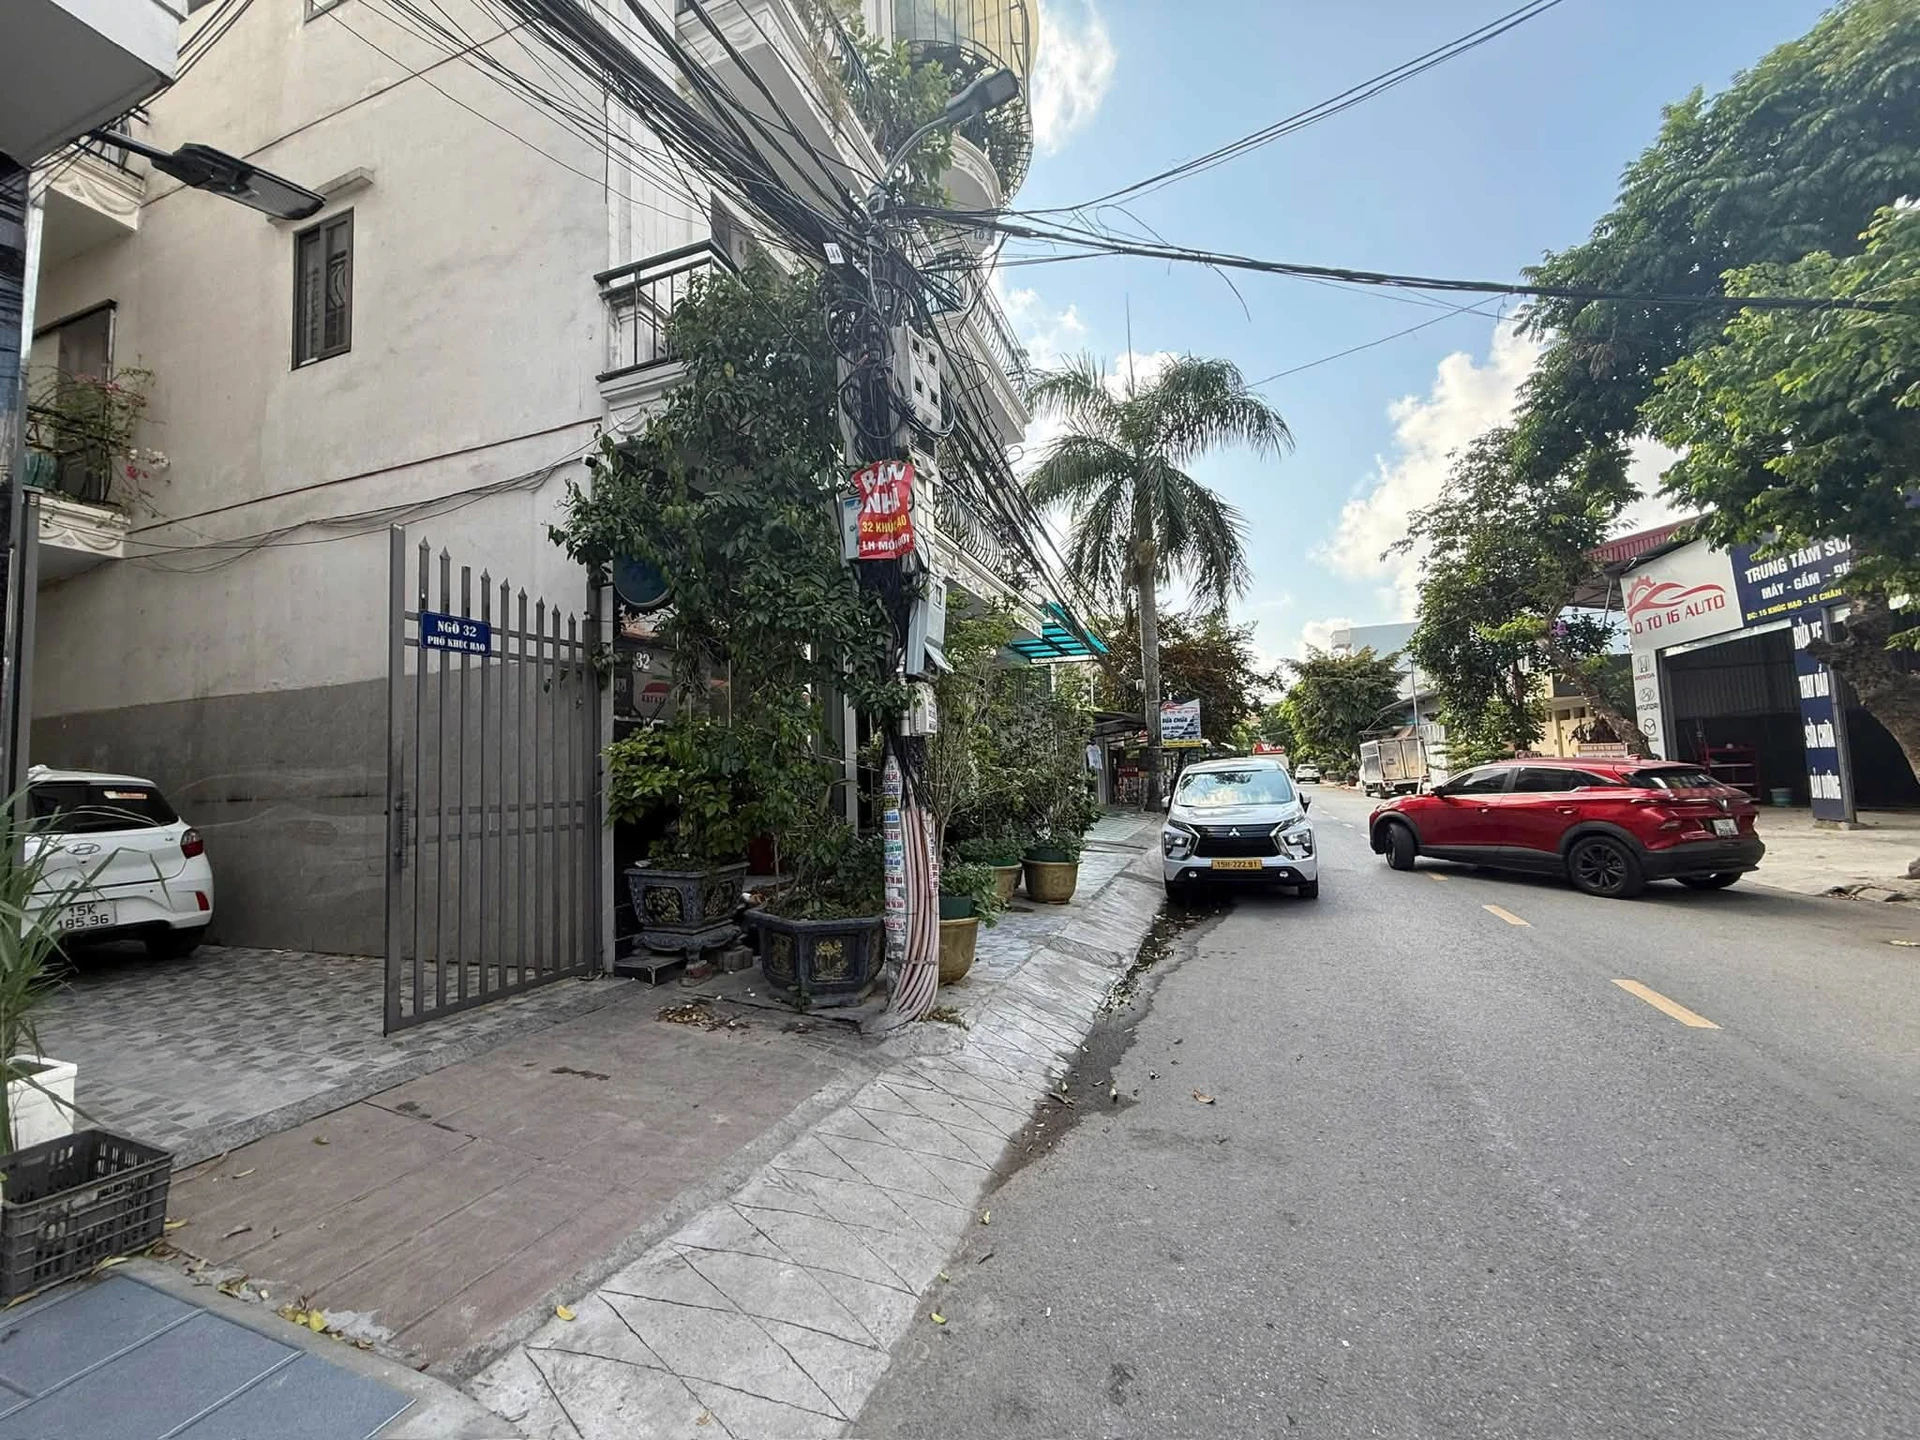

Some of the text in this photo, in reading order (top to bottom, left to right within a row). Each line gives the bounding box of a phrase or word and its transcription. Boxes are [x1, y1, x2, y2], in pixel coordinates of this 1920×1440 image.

[861, 521, 874, 533] 32
[1745, 557, 1788, 584] TRUNG
[1789, 545, 1822, 568] TÂM
[1761, 583, 1784, 600] MÁY
[1665, 608, 1680, 625] 16
[1684, 594, 1726, 619] AUTO
[437, 620, 477, 638] NGÕ 32
[427, 635, 445, 646] PHỐ
[636, 652, 650, 670] 32
[68, 903, 97, 917] 15K
